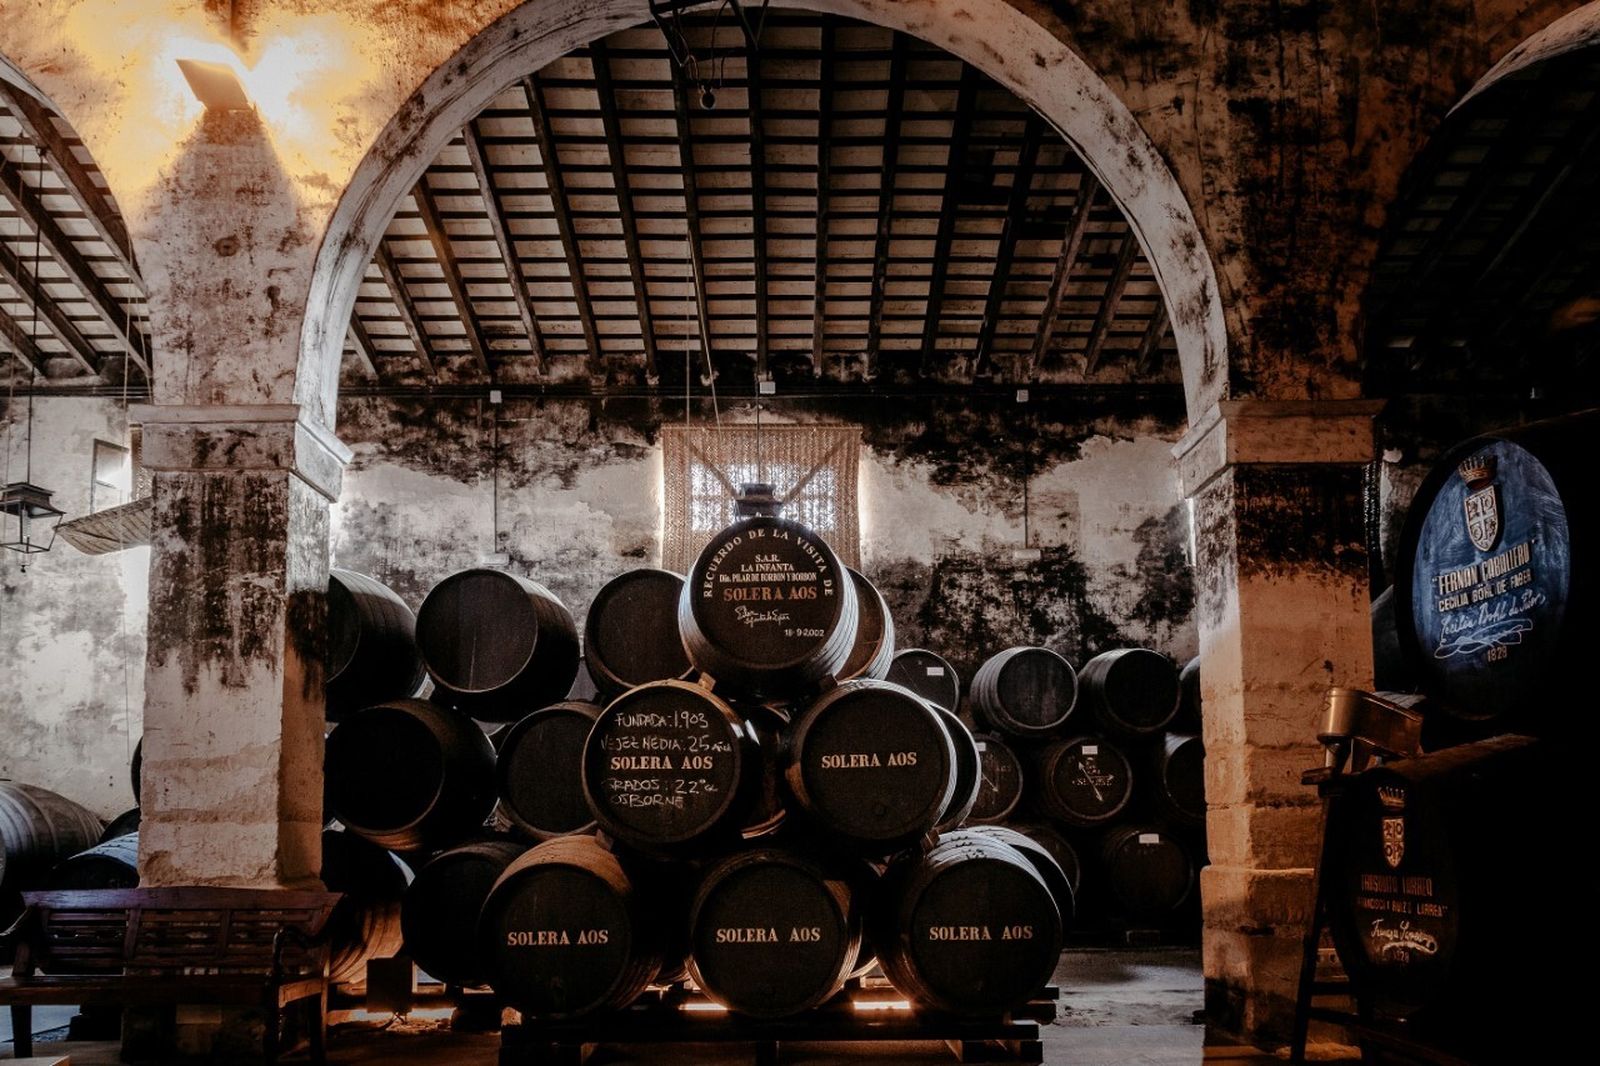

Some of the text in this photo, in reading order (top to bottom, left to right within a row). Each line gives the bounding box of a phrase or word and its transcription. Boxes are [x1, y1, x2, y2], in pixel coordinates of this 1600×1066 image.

[703, 528, 833, 598] RECUERDO DE LA VISITA DE
[755, 553, 780, 563] S.A.R.
[740, 563, 795, 573] LA INFANTA
[732, 573, 751, 583] PILAR
[723, 585, 818, 602] SOLERA AOS
[1438, 593, 1470, 612] CECILIA
[1497, 579, 1508, 595] DE
[687, 735, 710, 752] 25
[610, 755, 713, 770] SOLERA AOS
[821, 751, 918, 769] SOLERA AOS
[507, 929, 609, 946] SOLERA AOS
[716, 927, 821, 943] SOLERA AOS
[929, 925, 1033, 941] SOLERA AOS
